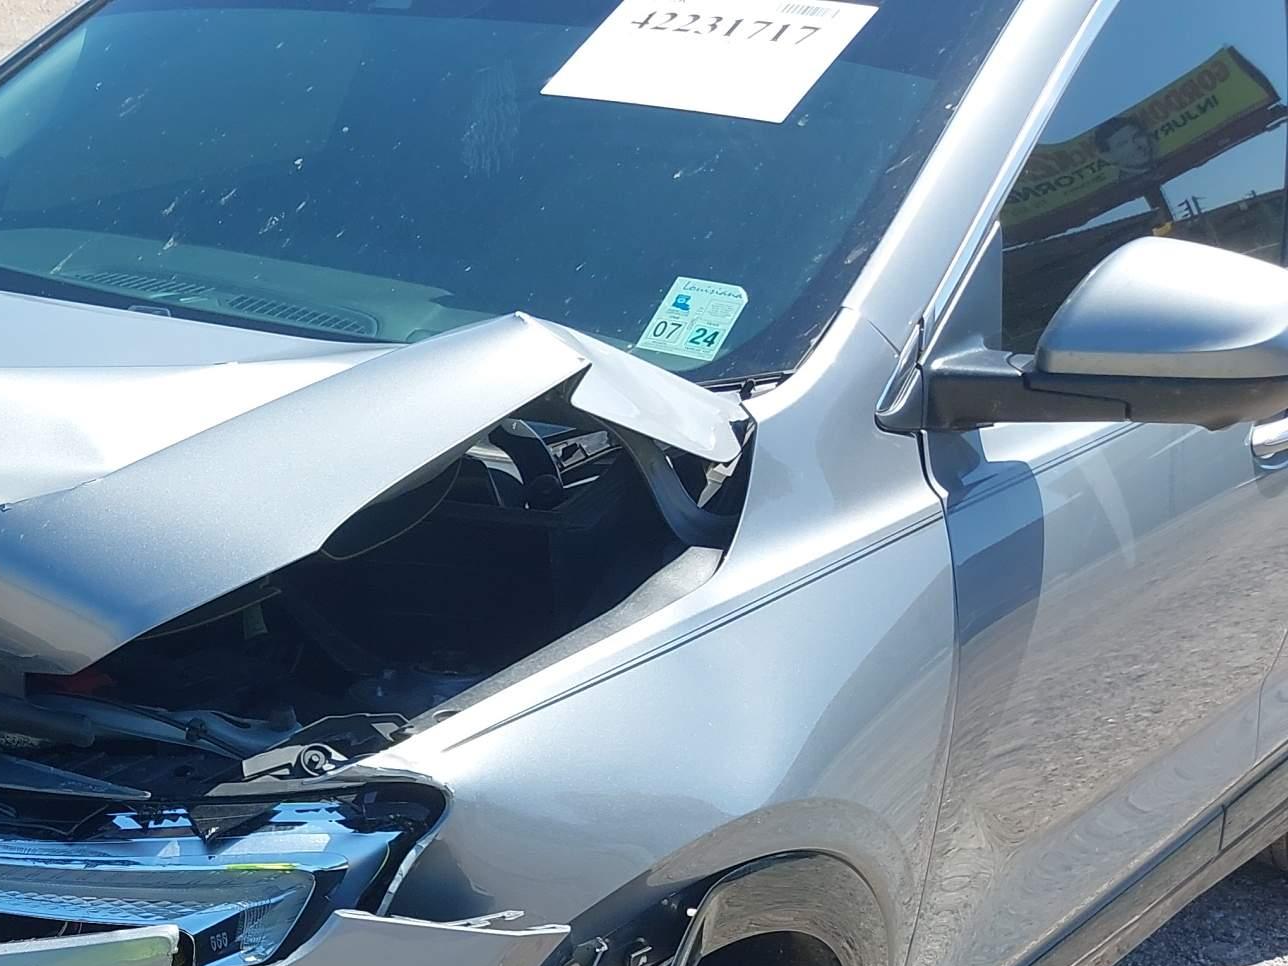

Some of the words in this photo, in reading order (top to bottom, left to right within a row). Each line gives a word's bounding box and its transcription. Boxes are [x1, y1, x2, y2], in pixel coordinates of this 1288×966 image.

[630, 10, 823, 45] 42231717
[653, 320, 682, 340] 07
[689, 327, 720, 348] 24
